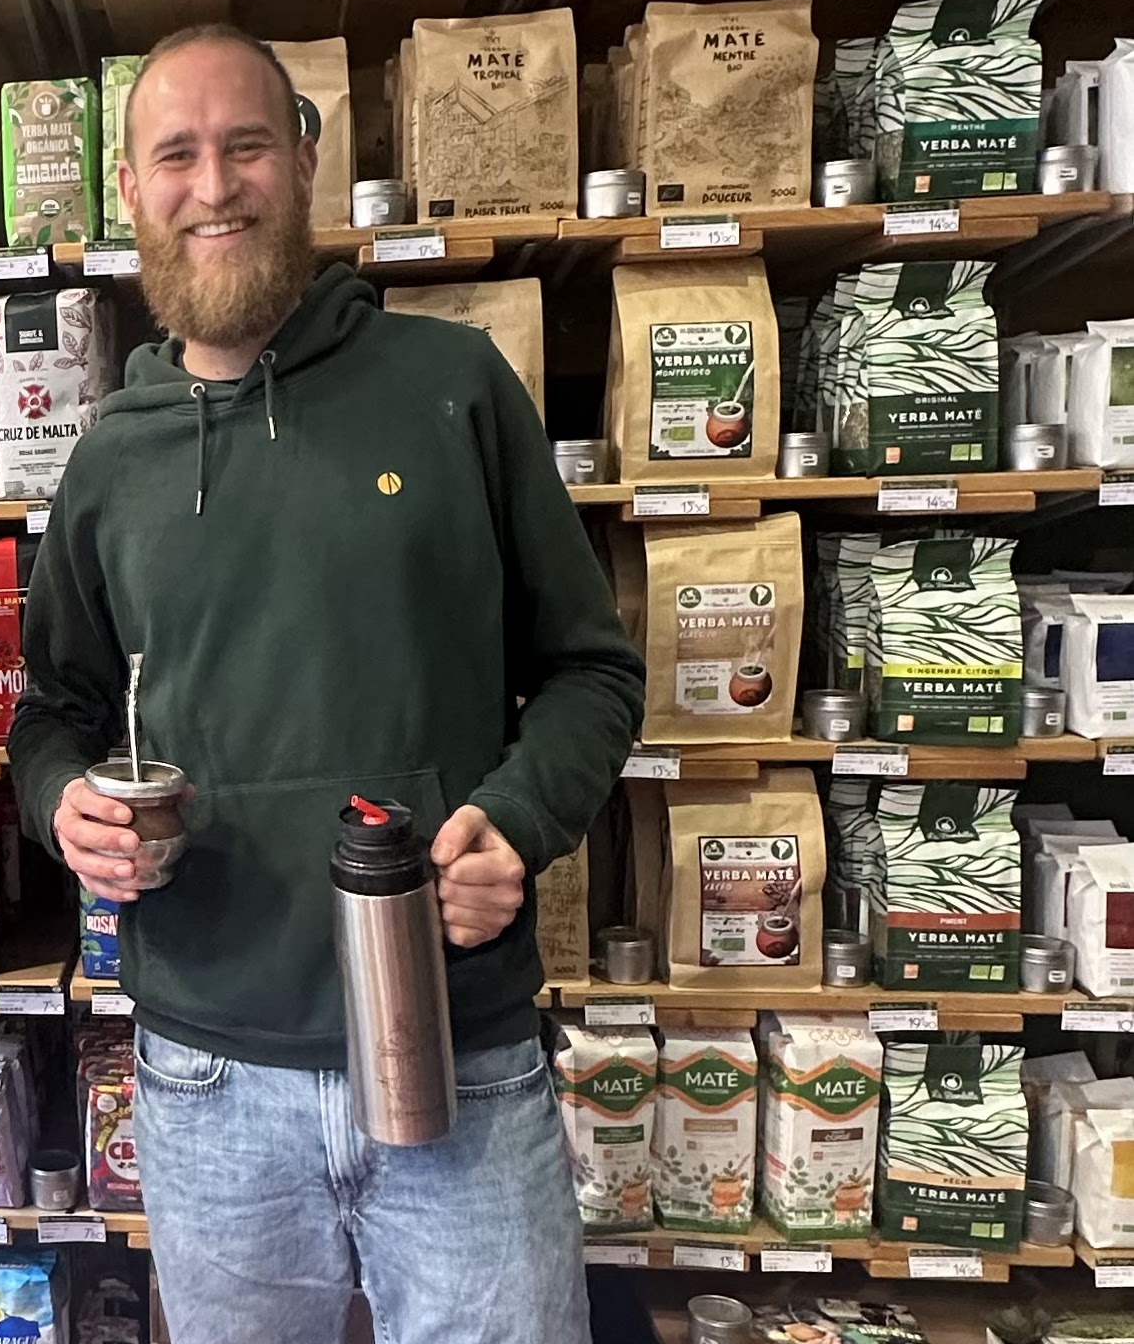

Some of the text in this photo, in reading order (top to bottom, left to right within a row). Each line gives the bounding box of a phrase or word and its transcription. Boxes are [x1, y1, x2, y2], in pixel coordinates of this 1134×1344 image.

[703, 29, 766, 50] MATÉ
[467, 49, 525, 69] MATÉ
[713, 50, 756, 62] MENTHE
[473, 69, 522, 82] TROPICAL
[22, 122, 72, 136] YERBA MATE
[950, 122, 986, 132] MENTHE
[920, 136, 1017, 152] YERBA MATÉ
[17, 156, 81, 185] amanda
[702, 187, 797, 204] DOUCEUR 500G
[466, 206, 497, 218] PLAISIR
[540, 200, 564, 210] 500G
[655, 352, 747, 367] YERBA MATÉ
[655, 368, 711, 377] MONTEVIDEO
[915, 395, 958, 405] ORIGINAL
[888, 409, 983, 424] YERBA MATÉ
[26, 426, 40, 440] DE
[42, 423, 78, 439] MALTA
[679, 614, 771, 629] YERBA MATÉ
[907, 666, 1001, 676] GINGEMBRE CITRON
[903, 681, 1003, 694] YERBA MATÉ
[704, 866, 795, 882] YERBA MATÉ
[86, 914, 119, 936] ROSA
[908, 931, 1004, 944] YERBA MATÉ
[593, 1073, 643, 1094] MATÉ
[686, 1069, 738, 1088] MATÉ
[815, 1079, 866, 1097] MATÉ
[108, 1141, 136, 1160] CB
[908, 1186, 1006, 1204] YERBA MATÉ
